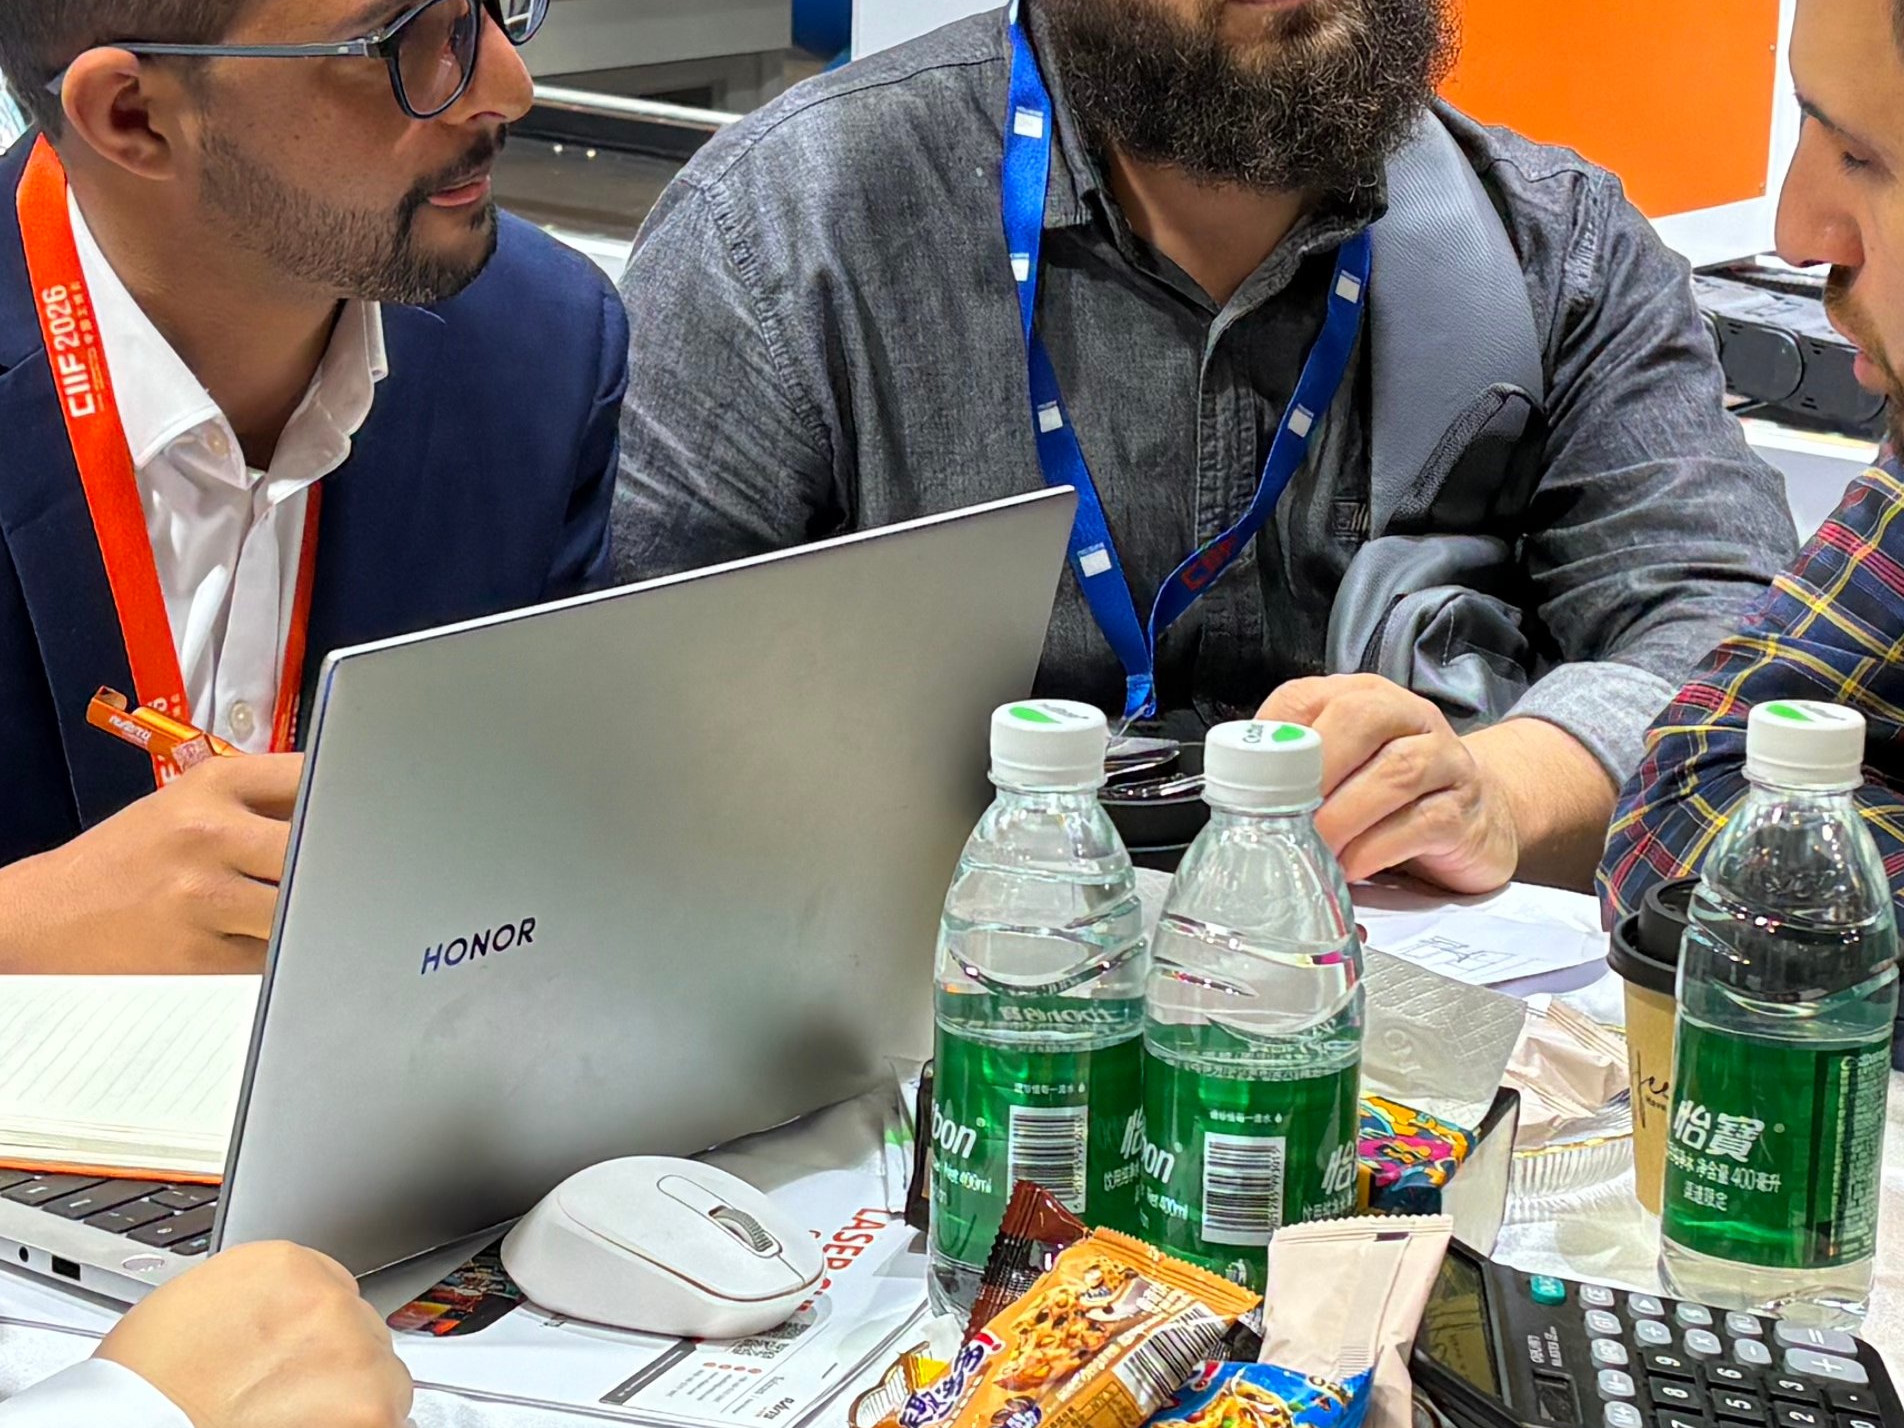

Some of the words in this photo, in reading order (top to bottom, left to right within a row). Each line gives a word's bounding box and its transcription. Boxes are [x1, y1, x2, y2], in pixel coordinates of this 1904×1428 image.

[41, 284, 81, 352] 2026
[58, 353, 96, 418] CIIF
[421, 917, 536, 974] HONOR
[1655, 1355, 1681, 1368] 9
[1662, 1386, 1689, 1399] 8
[1725, 1397, 1752, 1411] 5
[1788, 1411, 1816, 1424] 2
